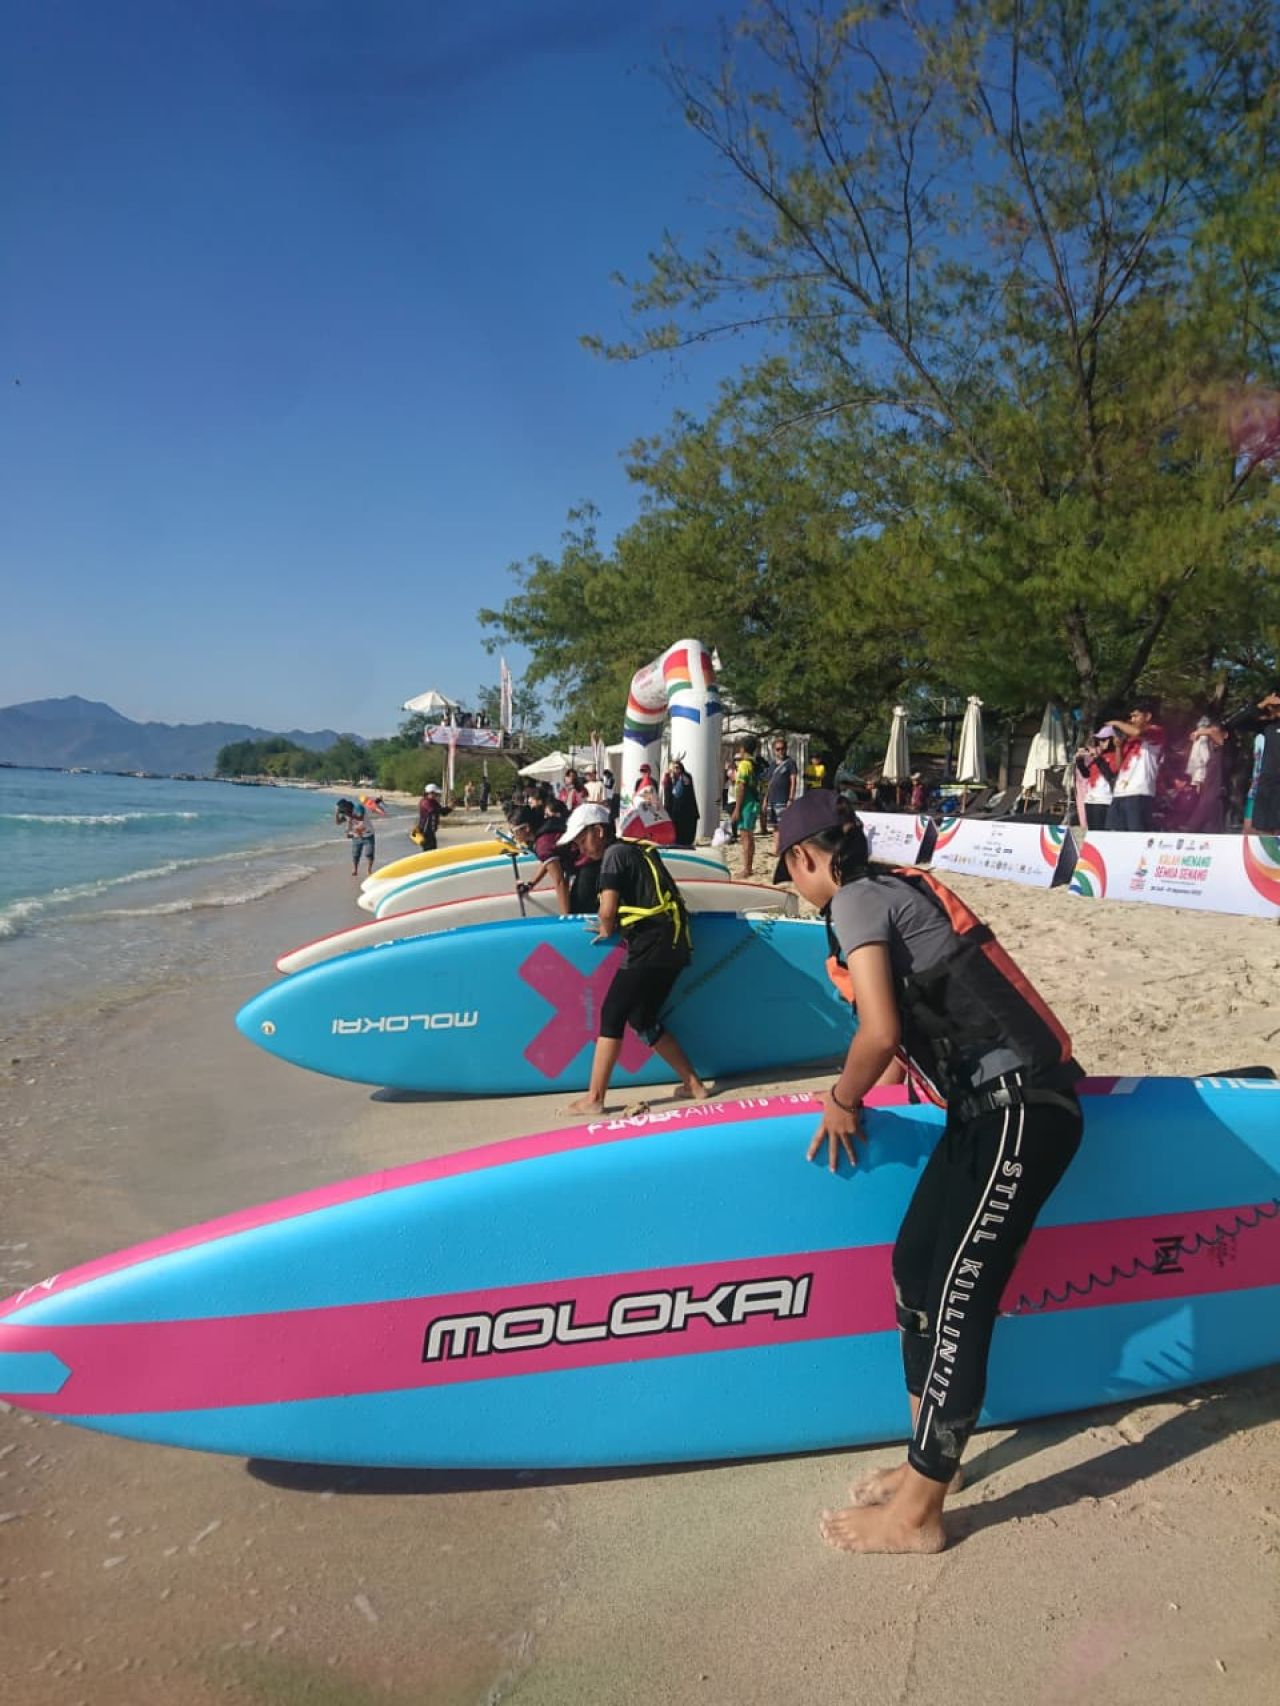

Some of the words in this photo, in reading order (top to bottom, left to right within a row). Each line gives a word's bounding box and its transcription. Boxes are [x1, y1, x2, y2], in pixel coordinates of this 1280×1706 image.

[331, 1011, 479, 1034] MOLOKAI
[684, 1102, 726, 1119] AIR
[972, 1160, 1022, 1244] STILL
[421, 1272, 814, 1363] MOLOKAI
